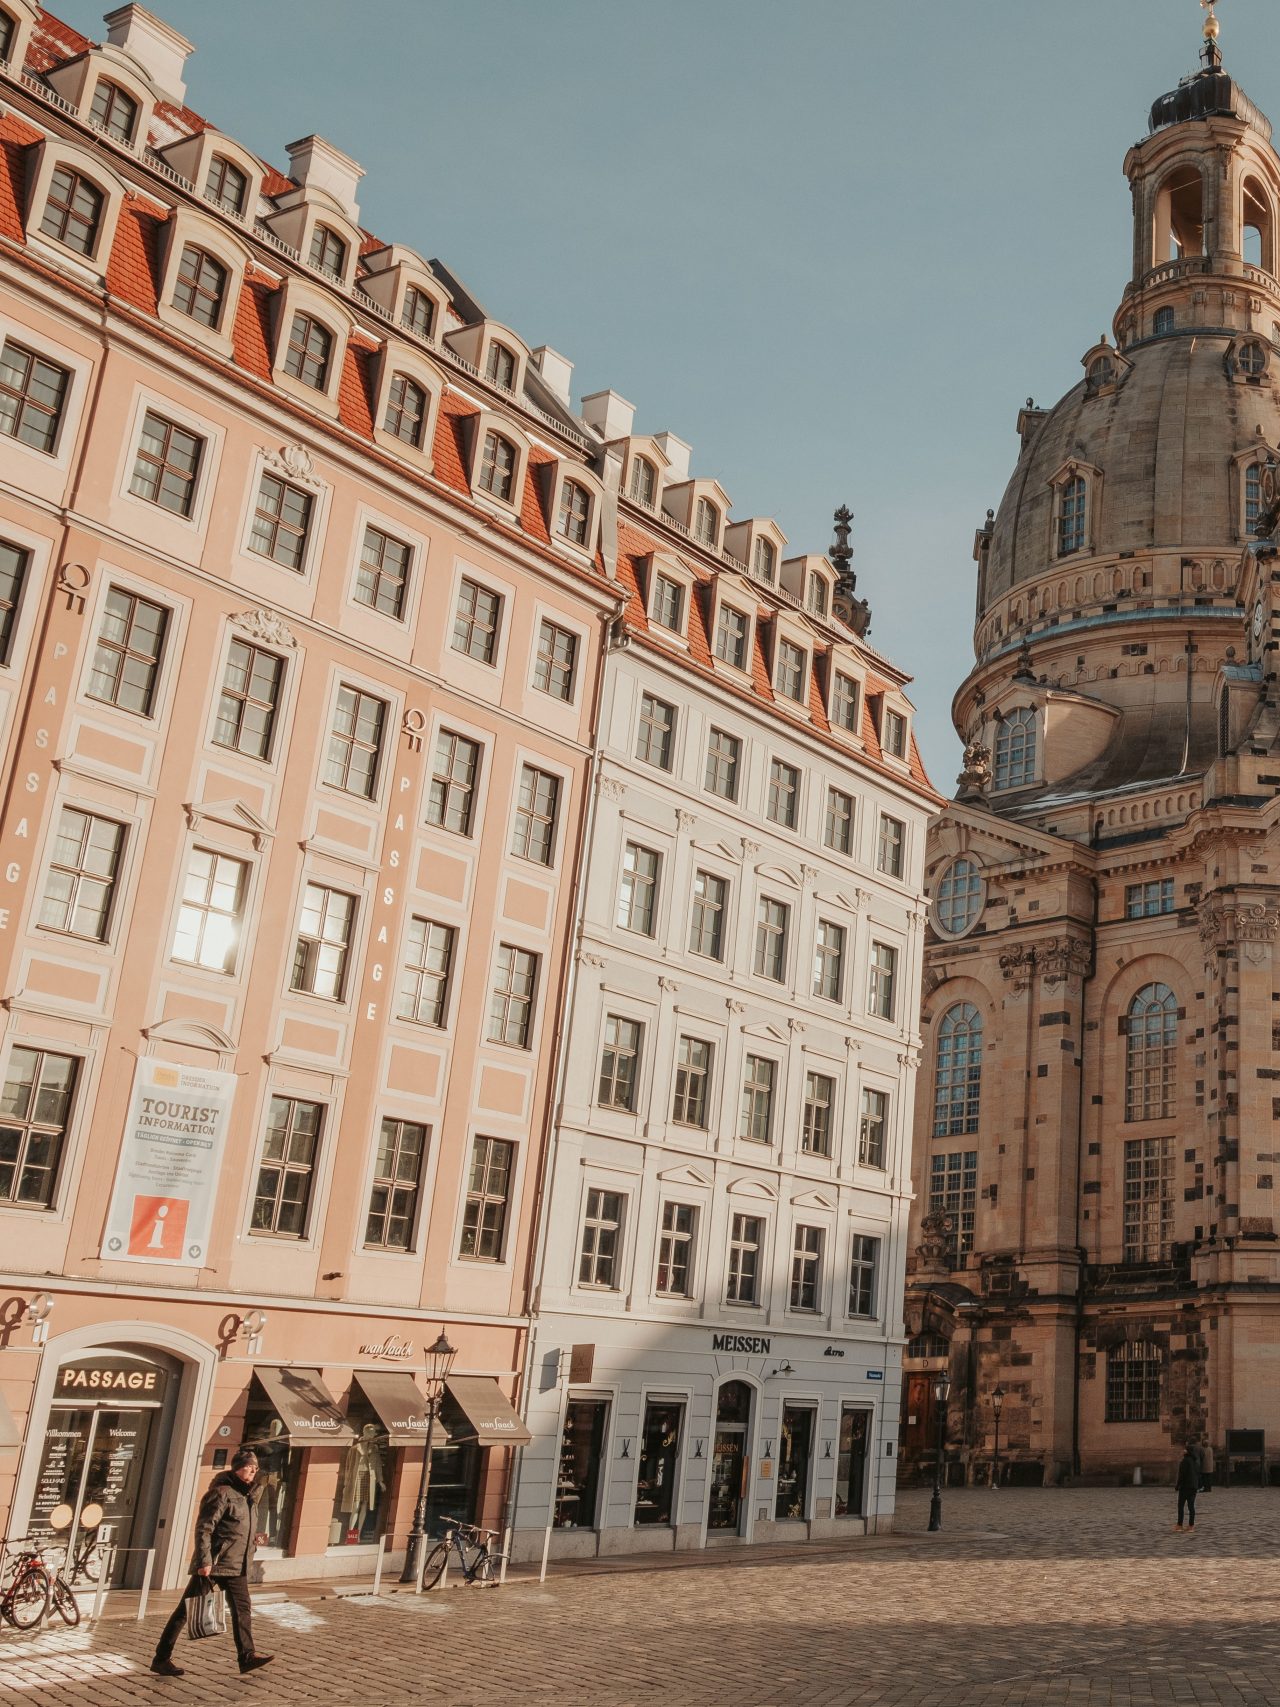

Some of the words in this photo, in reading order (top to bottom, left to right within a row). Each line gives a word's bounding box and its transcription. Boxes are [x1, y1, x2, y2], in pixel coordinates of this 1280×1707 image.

[0, 642, 68, 930] PASSAGE
[366, 776, 411, 1021] PASSAGE
[143, 1098, 220, 1124] TOURIST
[138, 1116, 215, 1136] INFORMATION
[712, 1334, 772, 1354] MEISSEN
[922, 1359, 929, 1369] D
[63, 1370, 157, 1390] PASSAGE
[109, 1429, 137, 1437] Welcome
[714, 1442, 739, 1453] EISSEN
